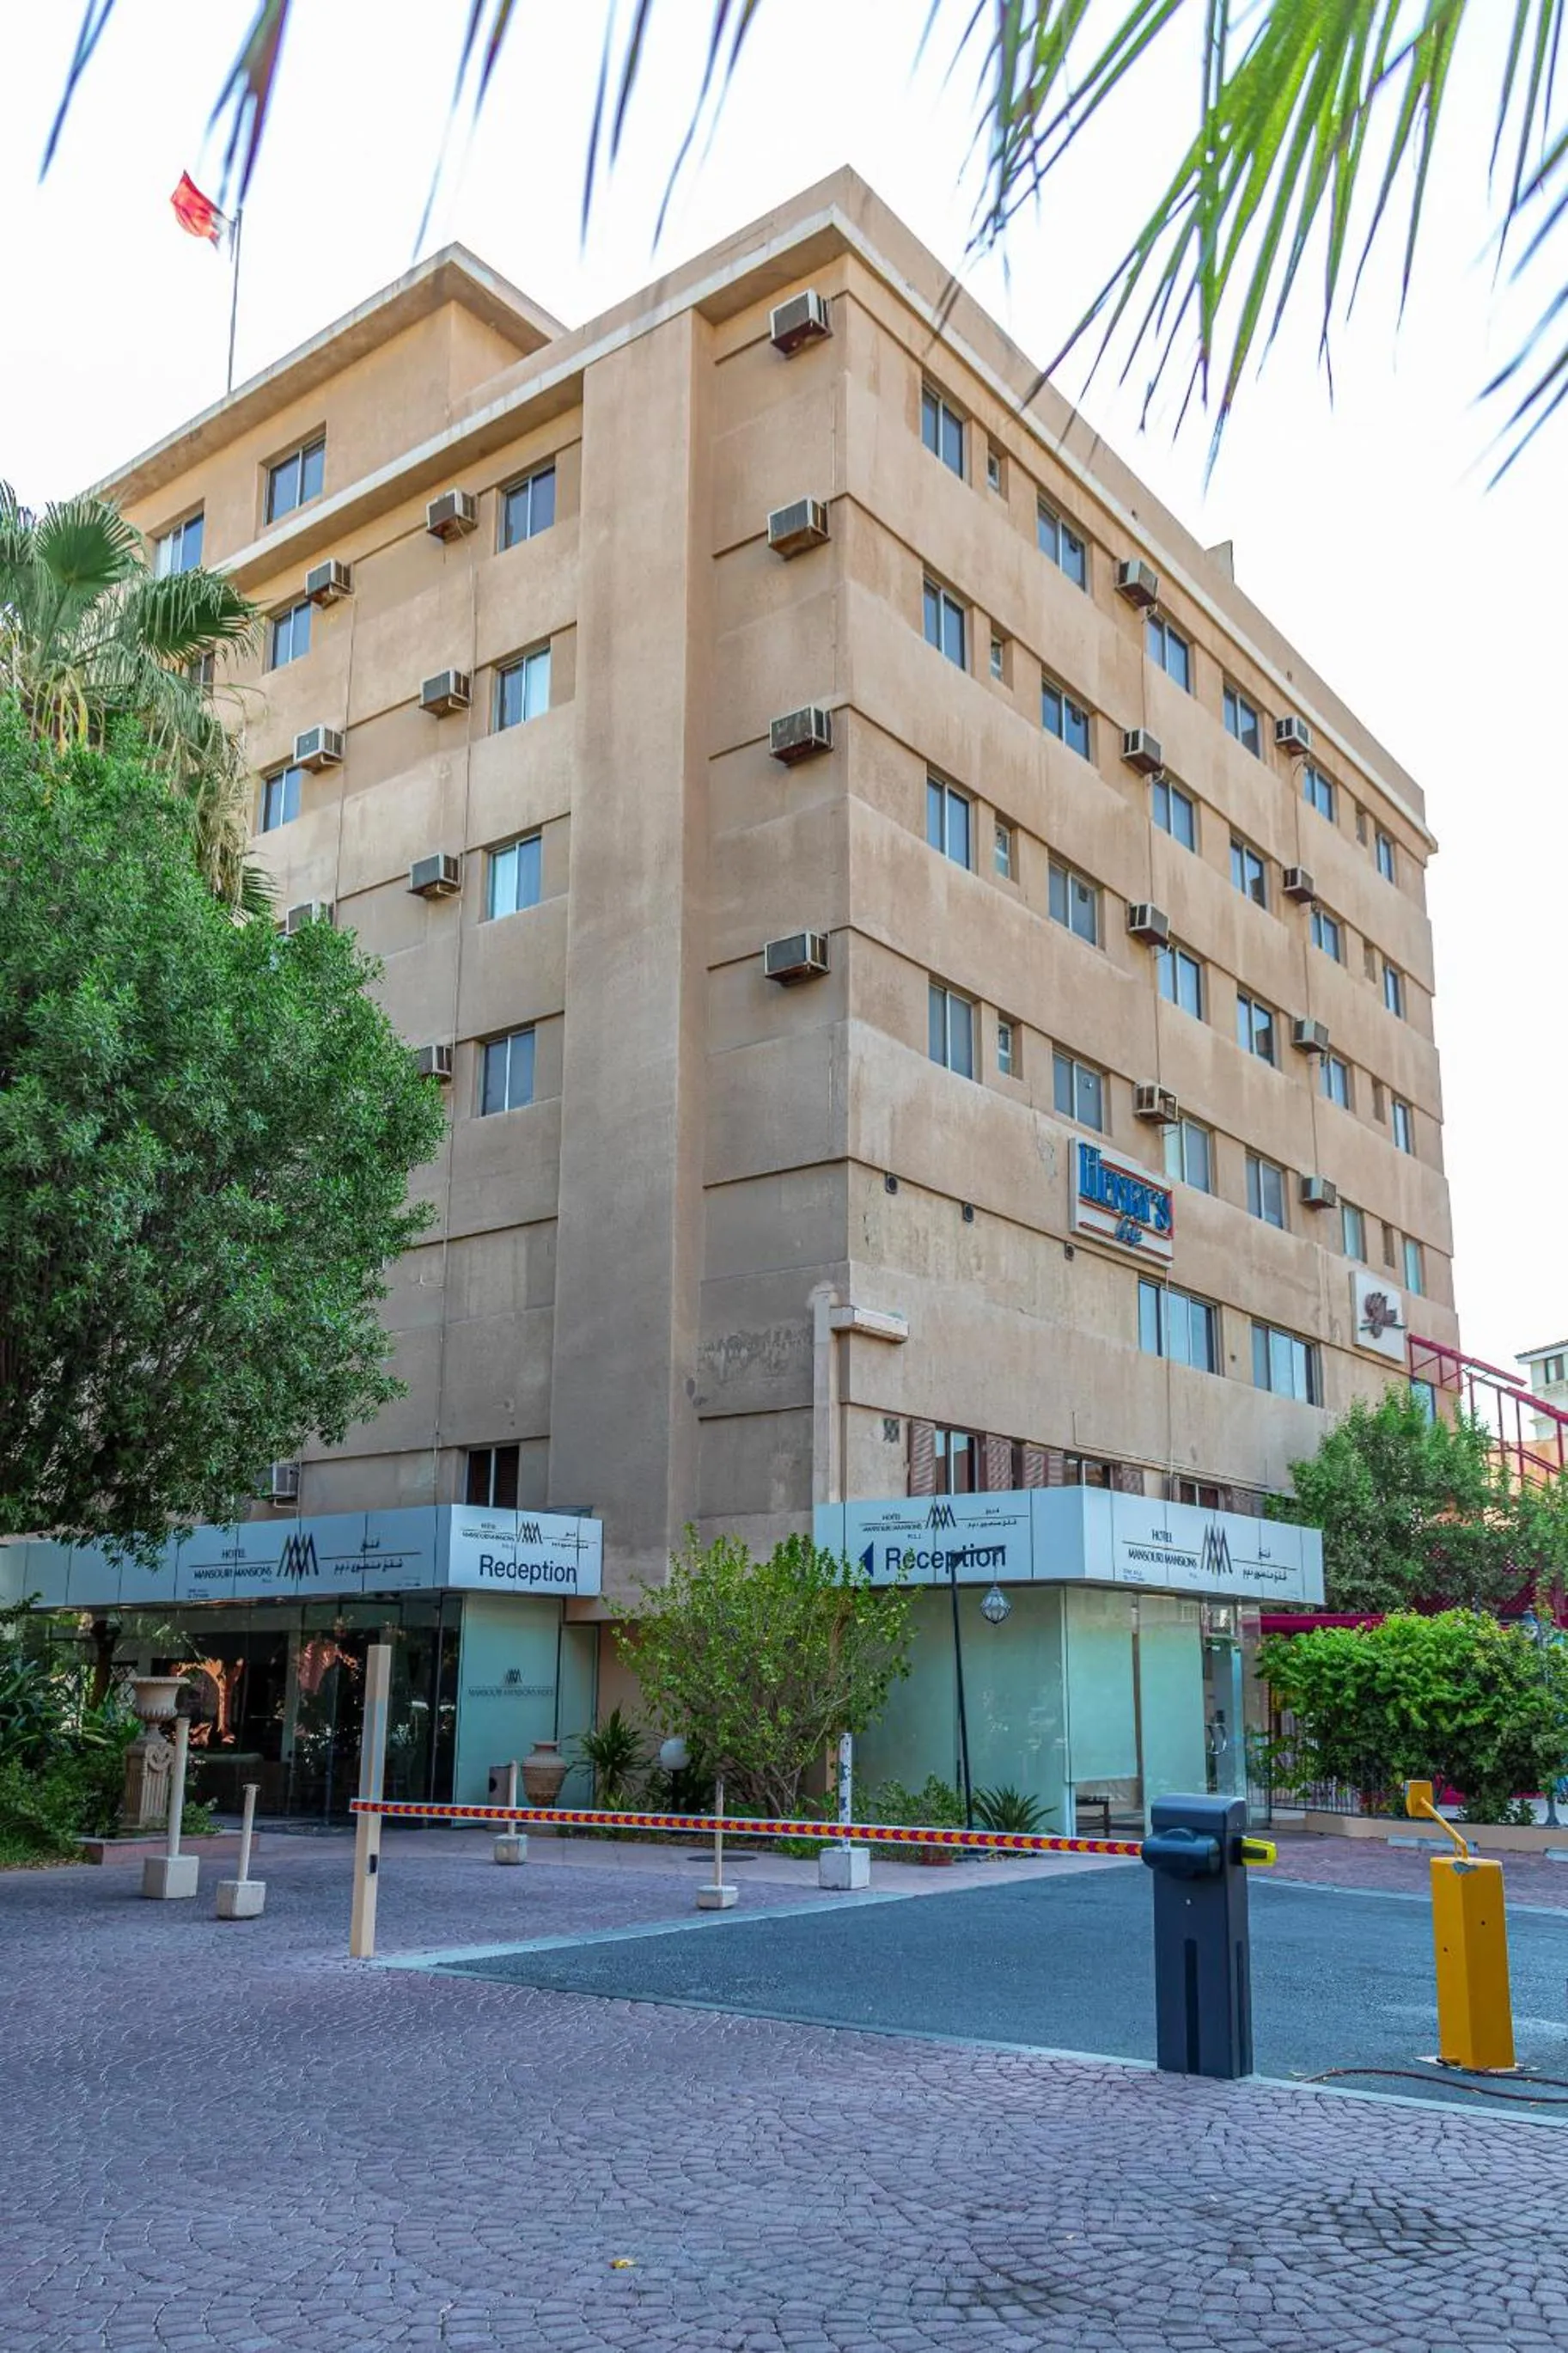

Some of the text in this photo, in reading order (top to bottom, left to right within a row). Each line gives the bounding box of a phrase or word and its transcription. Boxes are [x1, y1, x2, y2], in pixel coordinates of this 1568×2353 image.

[1152, 1530, 1172, 1543] HOTEL
[222, 1548, 247, 1559] HOTEL
[886, 1543, 1006, 1574] Reception
[1128, 1549, 1197, 1568] MANSOURI MANSIONS
[193, 1566, 272, 1579] MANSOURI MANSIONS
[479, 1554, 577, 1585] Reception
